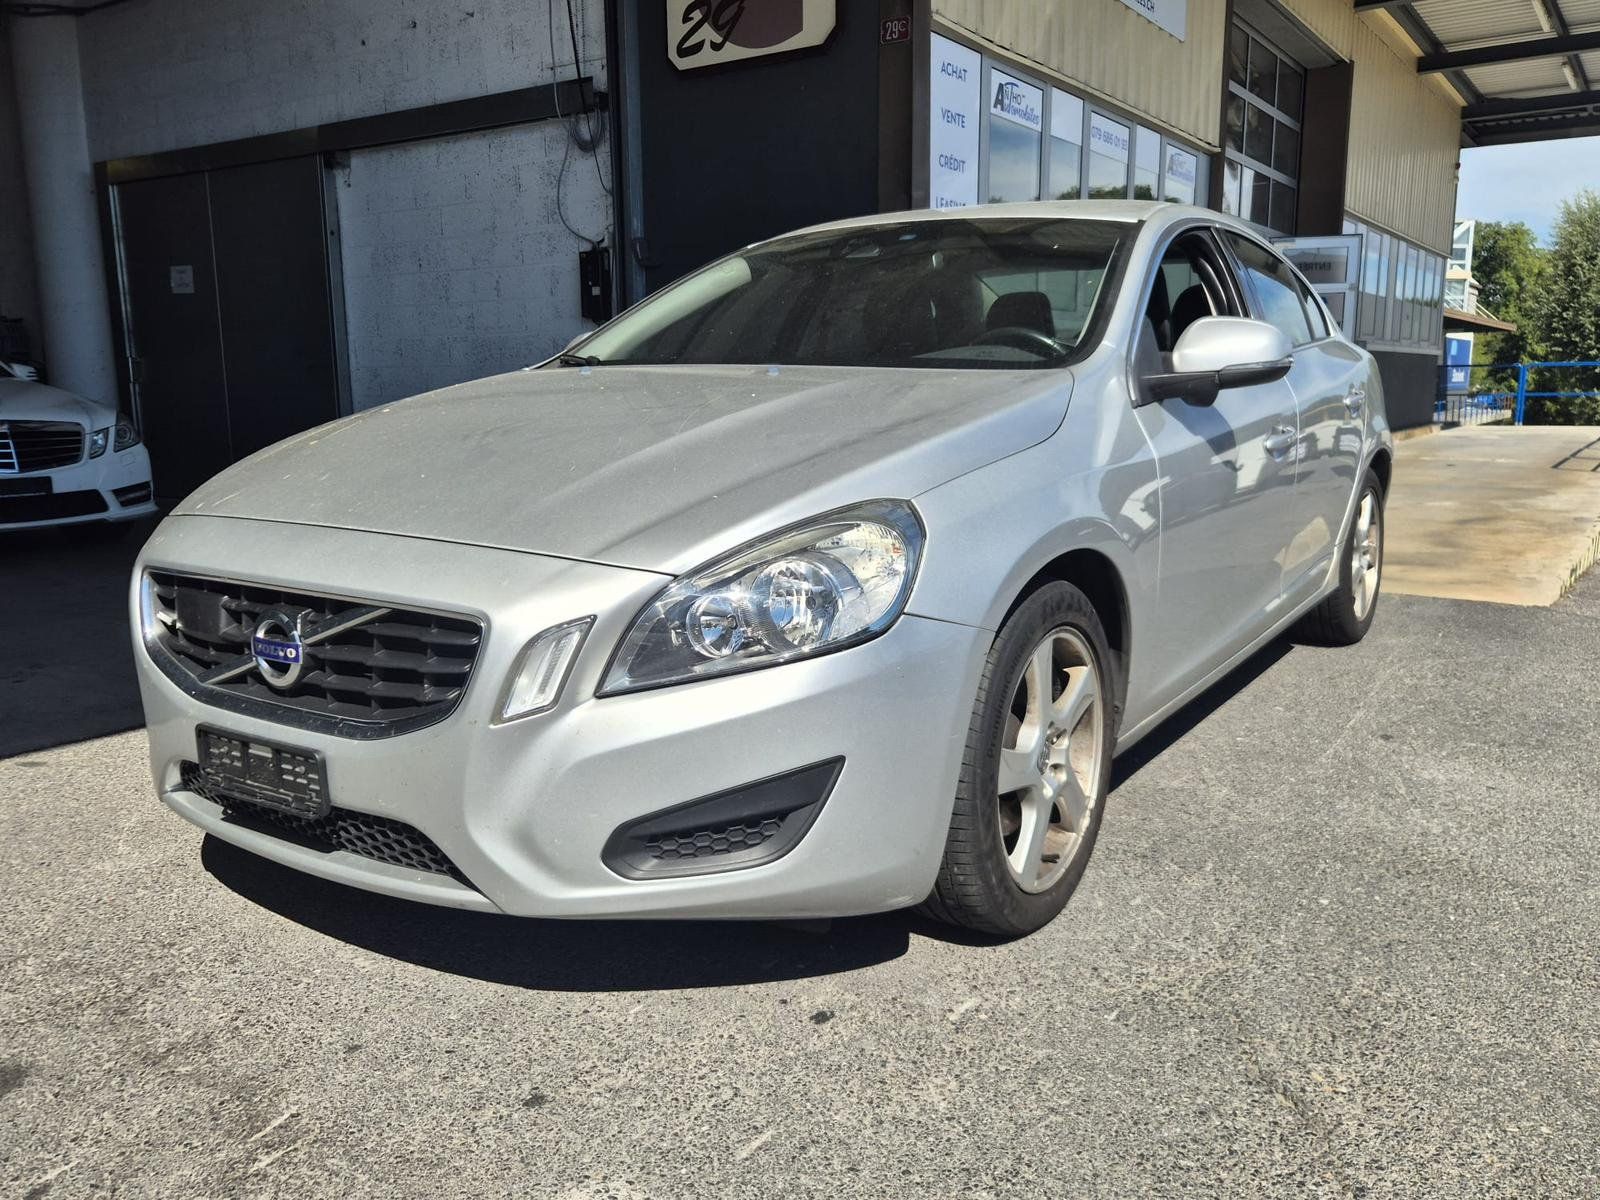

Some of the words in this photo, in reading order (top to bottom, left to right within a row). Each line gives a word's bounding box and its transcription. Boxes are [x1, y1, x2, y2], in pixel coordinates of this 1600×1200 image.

[941, 62, 968, 82] ACHAT
[941, 107, 966, 128] VENTE
[938, 153, 966, 174] CRÉDIT
[255, 642, 297, 659] VOLVO
